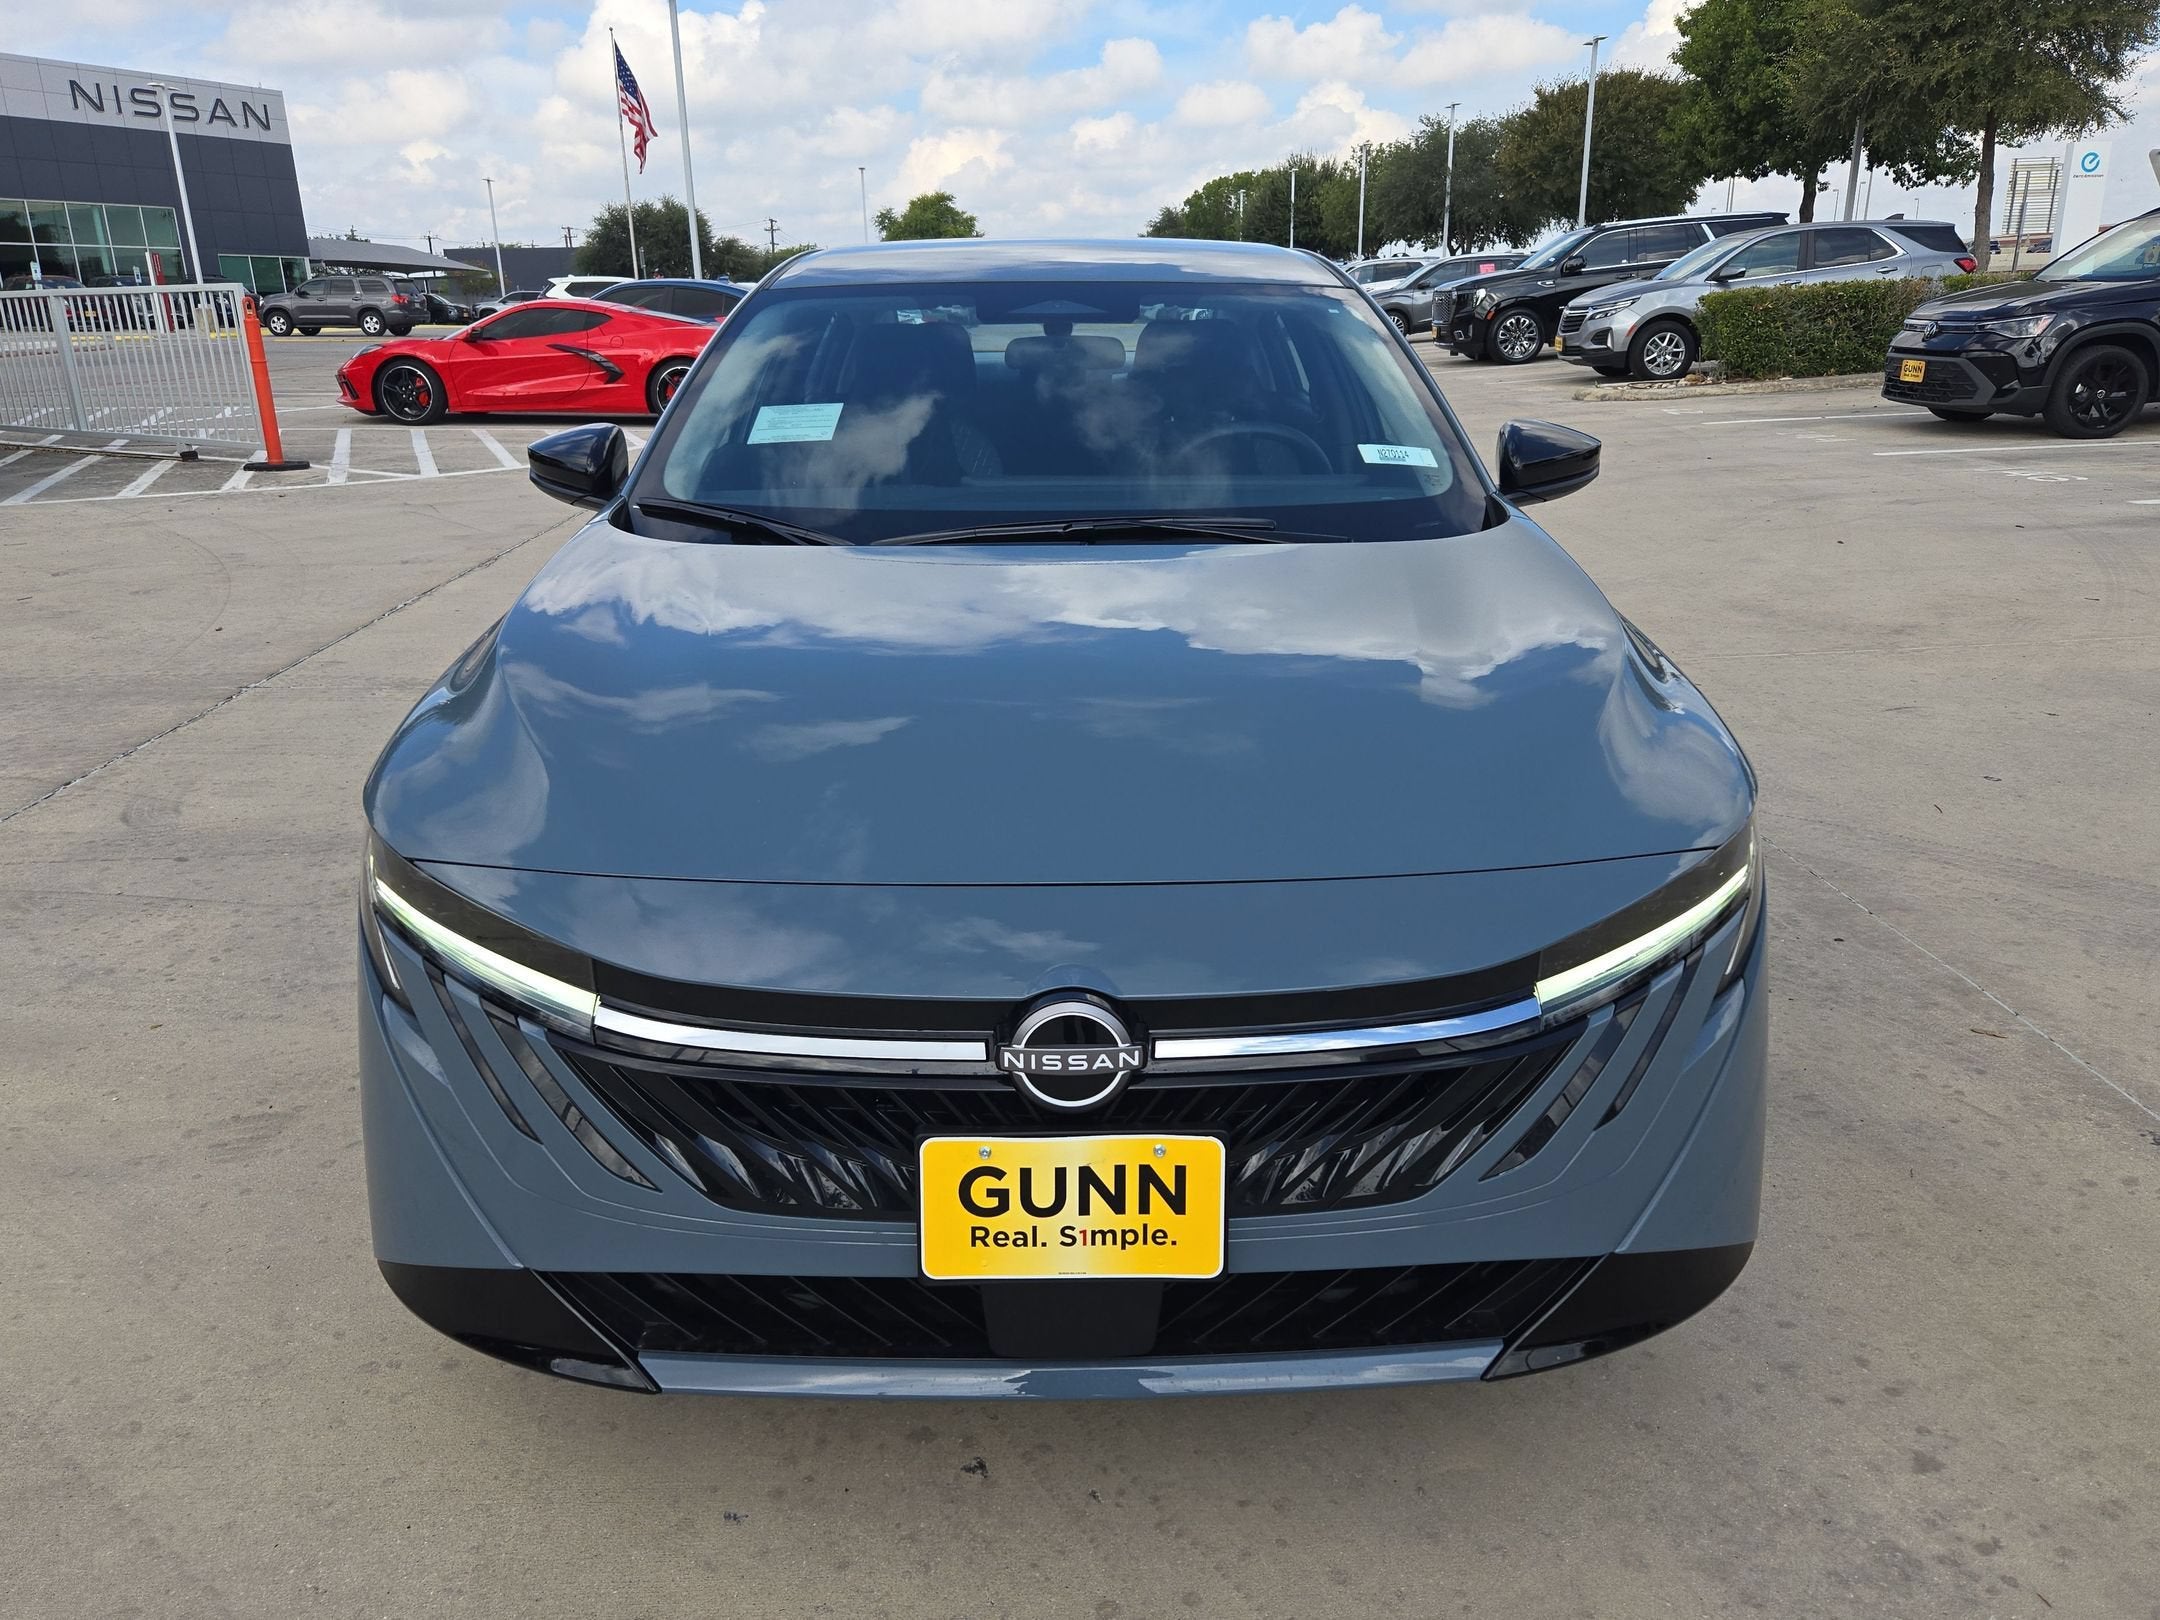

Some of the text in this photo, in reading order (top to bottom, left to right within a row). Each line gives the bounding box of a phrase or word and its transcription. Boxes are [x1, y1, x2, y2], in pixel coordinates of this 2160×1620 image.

[69, 79, 271, 131] NISSAN
[1904, 364, 1923, 374] GUNN
[1003, 1050, 1139, 1071] NISSAN
[958, 1163, 1187, 1218] GUNN
[970, 1223, 1177, 1250] Real. S1mple.
